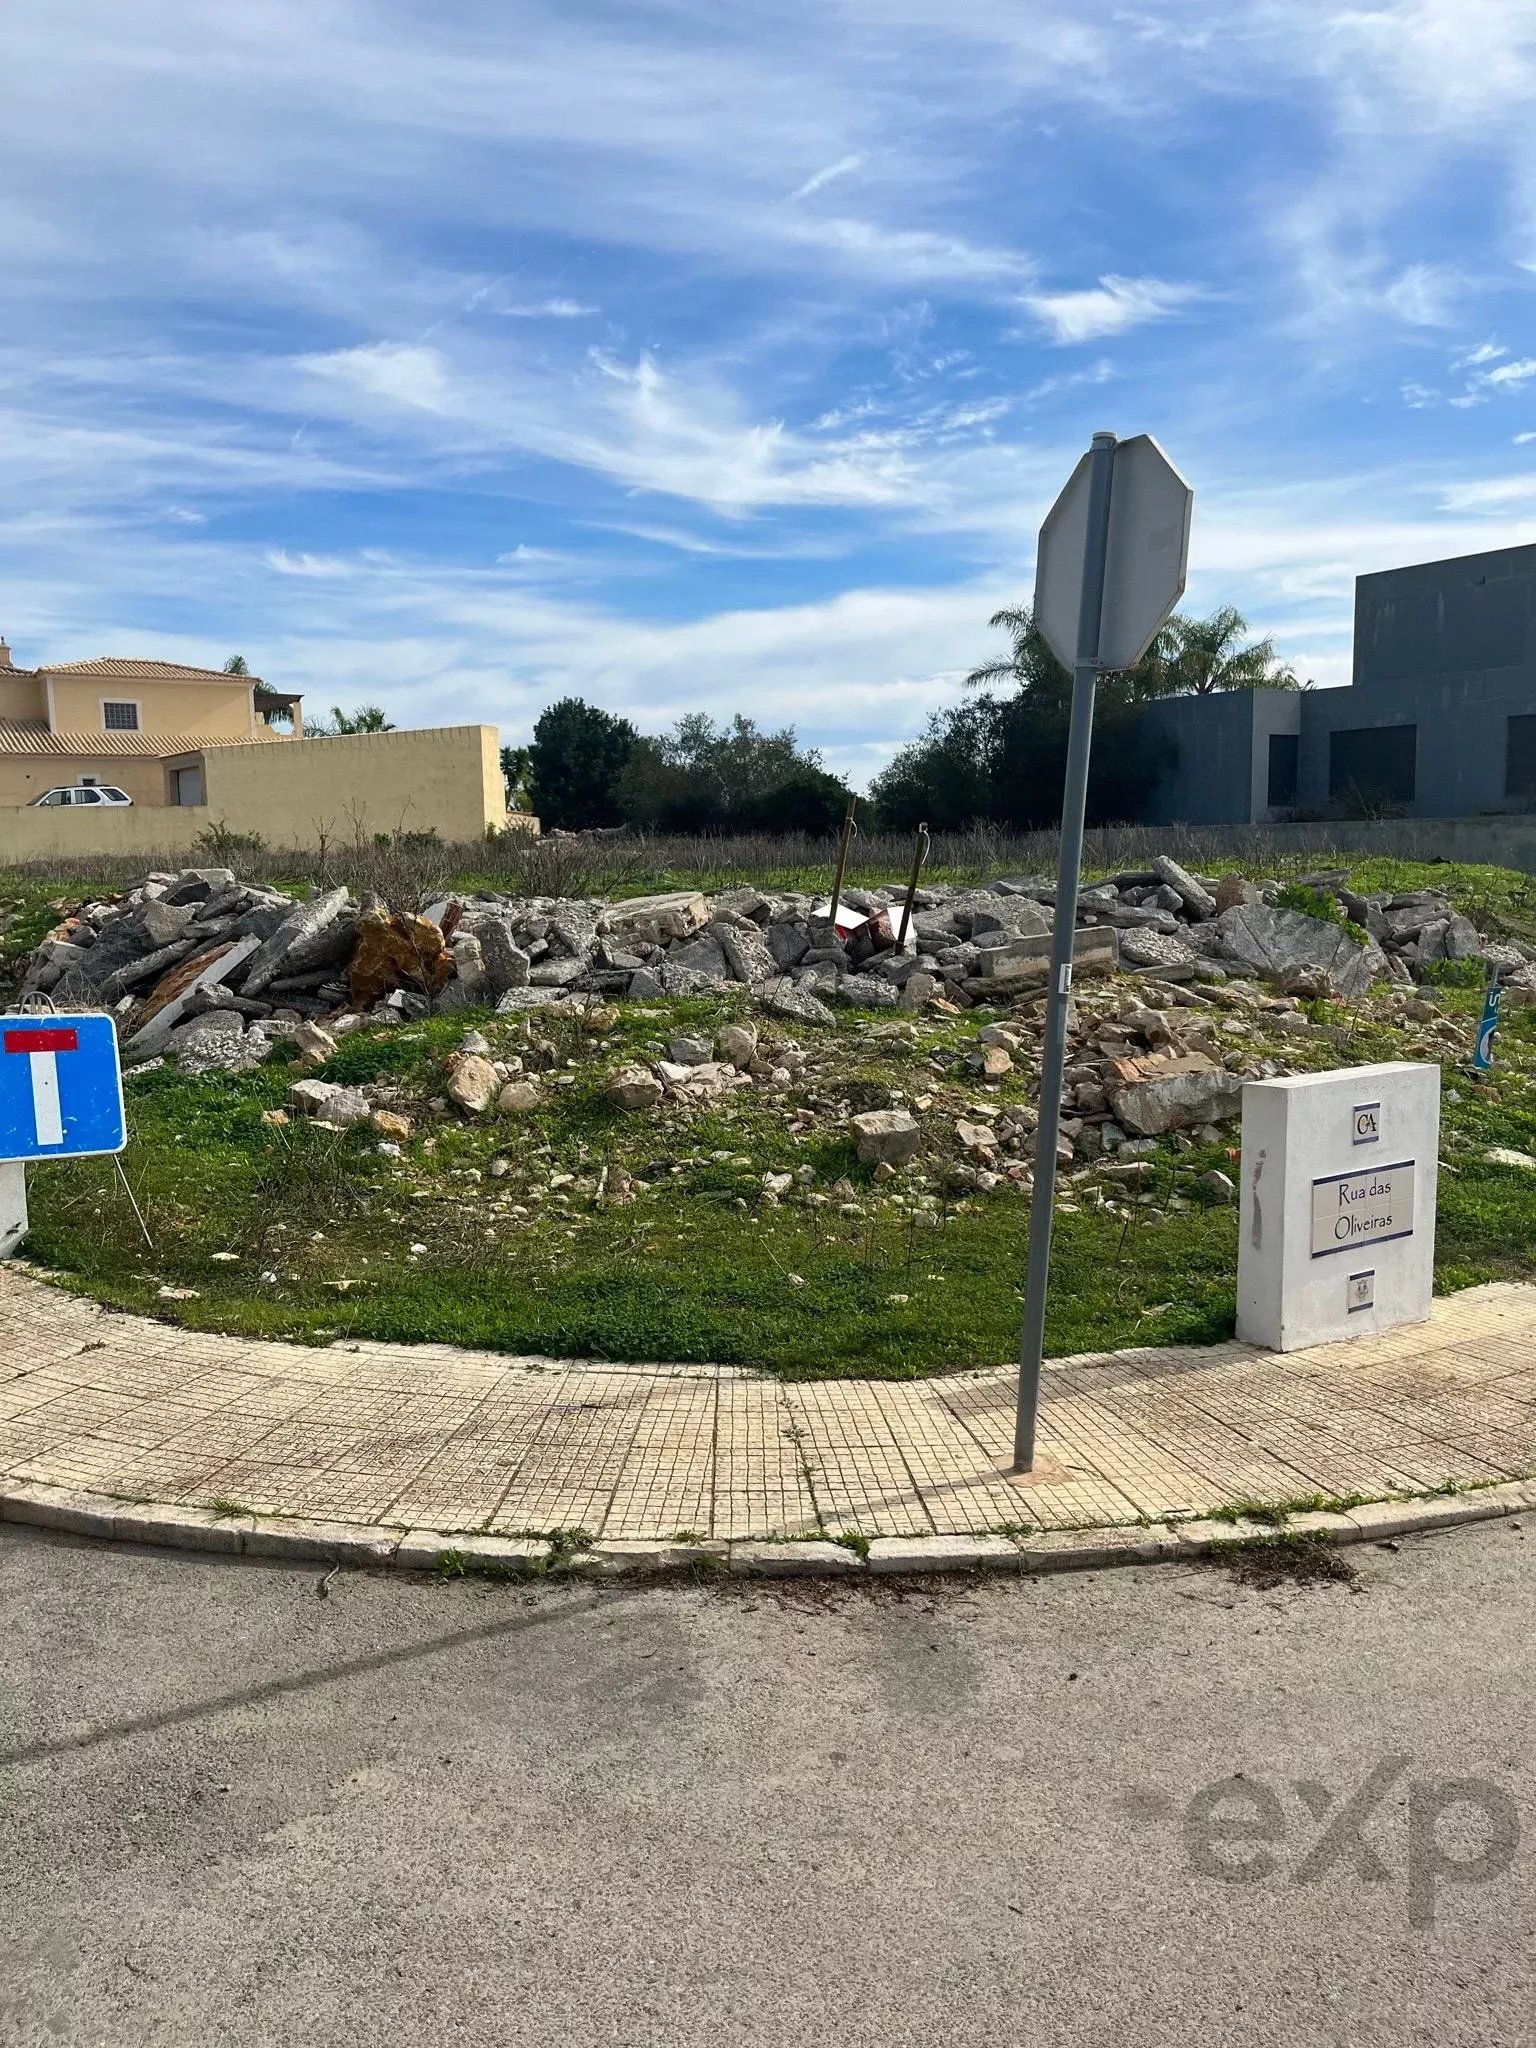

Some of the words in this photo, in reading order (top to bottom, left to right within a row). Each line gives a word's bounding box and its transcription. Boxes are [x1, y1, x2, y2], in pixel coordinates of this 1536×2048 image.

[1339, 1184, 1366, 1206] Rua
[1369, 1176, 1392, 1196] das
[1334, 1214, 1393, 1240] Oliveiras
